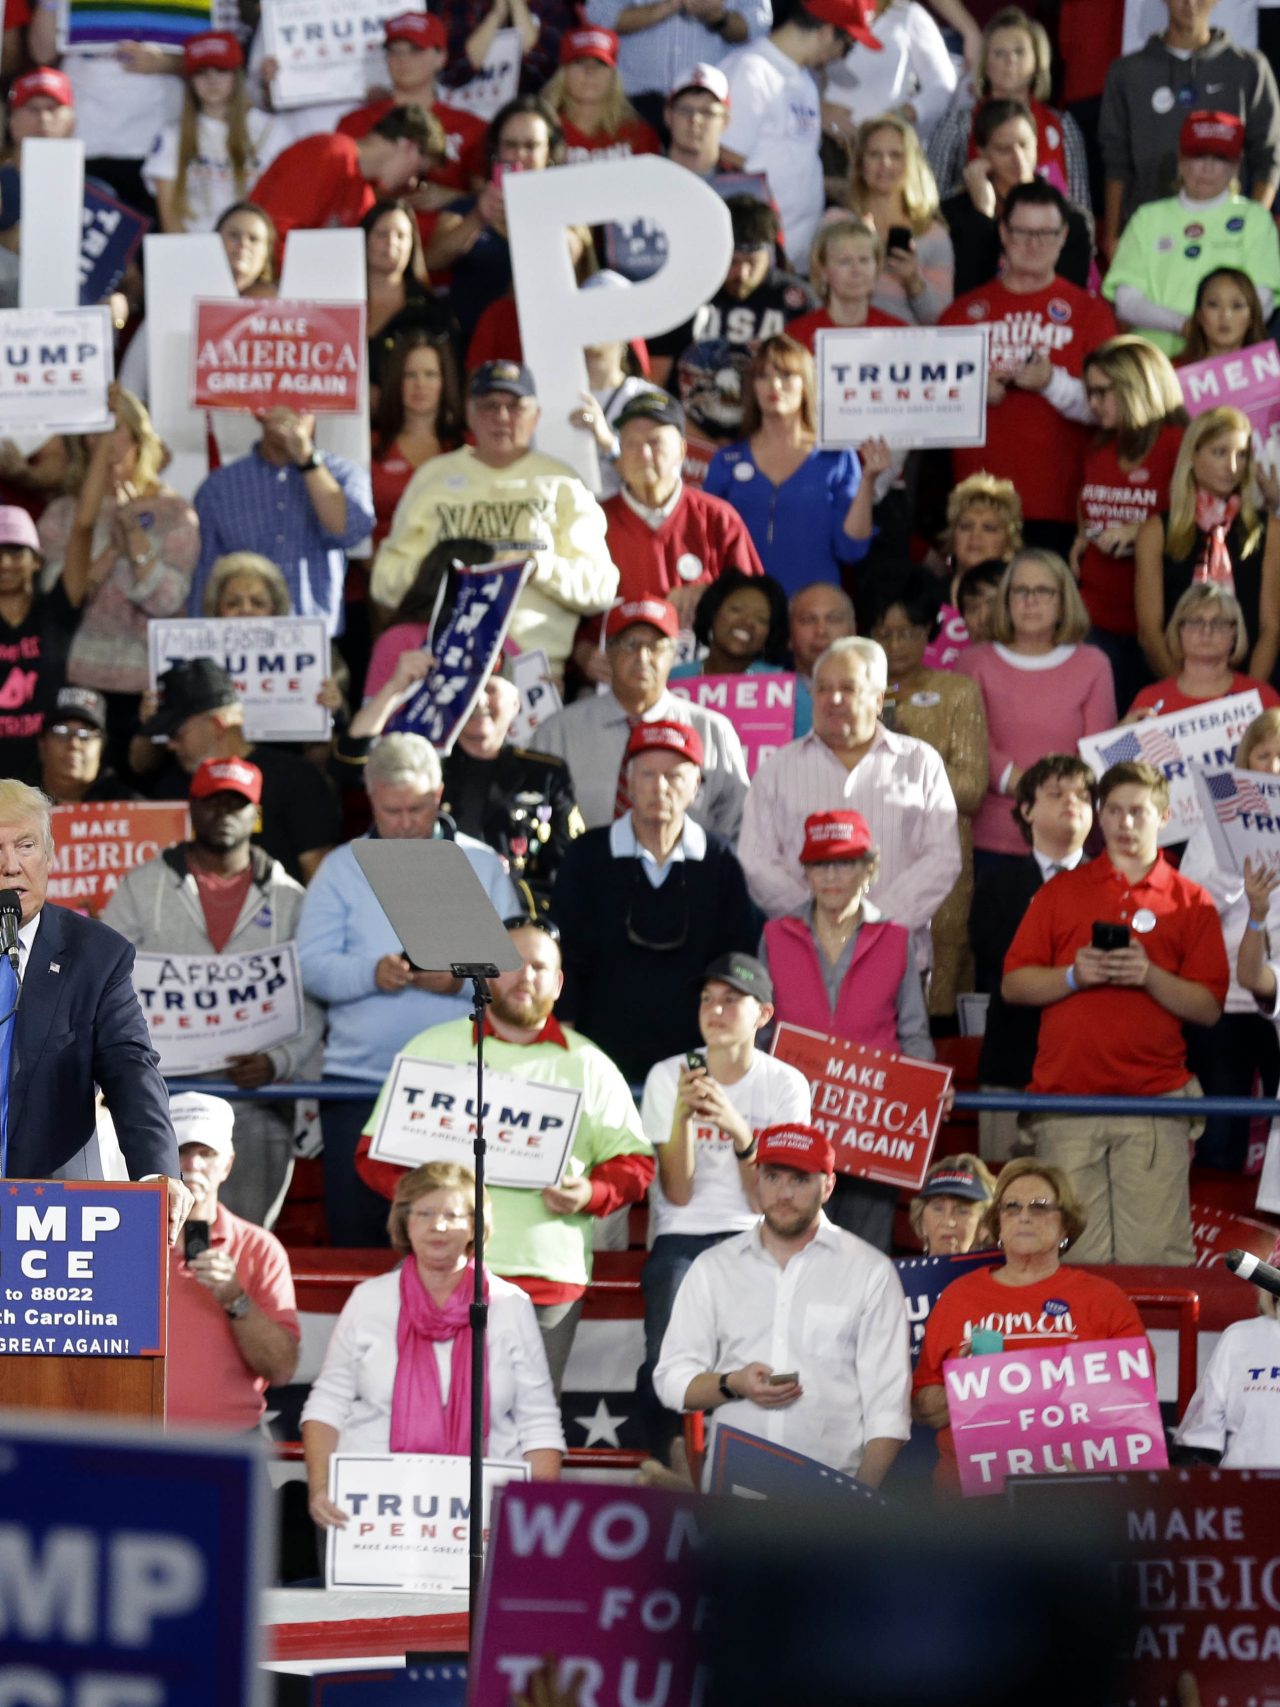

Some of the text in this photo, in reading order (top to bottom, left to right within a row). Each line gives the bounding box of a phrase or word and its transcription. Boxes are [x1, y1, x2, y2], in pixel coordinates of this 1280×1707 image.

[279, 18, 386, 44] TRUM
[248, 316, 309, 336] MAKE
[198, 339, 358, 371] AMERICA
[206, 371, 348, 396] GREAT AGAIN
[830, 361, 976, 385] TRUMP
[1186, 351, 1280, 403] MEN
[843, 387, 960, 401] PENCE
[165, 653, 315, 675] TUMP
[231, 679, 300, 693] NCE
[673, 681, 794, 709] MEN
[1166, 702, 1258, 740] VETERANS
[1226, 722, 1248, 741] FO
[71, 819, 130, 838] MAKE
[51, 840, 160, 871] MERIC
[46, 874, 100, 898] REAT
[139, 972, 287, 1011] TRUMP
[151, 1000, 277, 1029] PENCE
[825, 1056, 887, 1091] MAKE
[402, 1086, 564, 1132] TRUMP
[810, 1081, 930, 1138] ERICA
[409, 1110, 544, 1149] PENCE
[841, 1128, 915, 1162] AGAIN
[5, 1287, 23, 1301] to
[30, 1287, 94, 1302] 88022
[24, 1309, 119, 1327] Carolina
[62, 1338, 130, 1355] AGAIN!
[946, 1348, 1152, 1402] WOMEN
[1018, 1402, 1091, 1432] FOR
[969, 1433, 1153, 1484] TRUMP
[345, 1493, 471, 1521] TRUM
[1126, 1506, 1246, 1541] MAKE
[1131, 1555, 1280, 1612] ERIC
[1198, 1624, 1280, 1661] AGA
